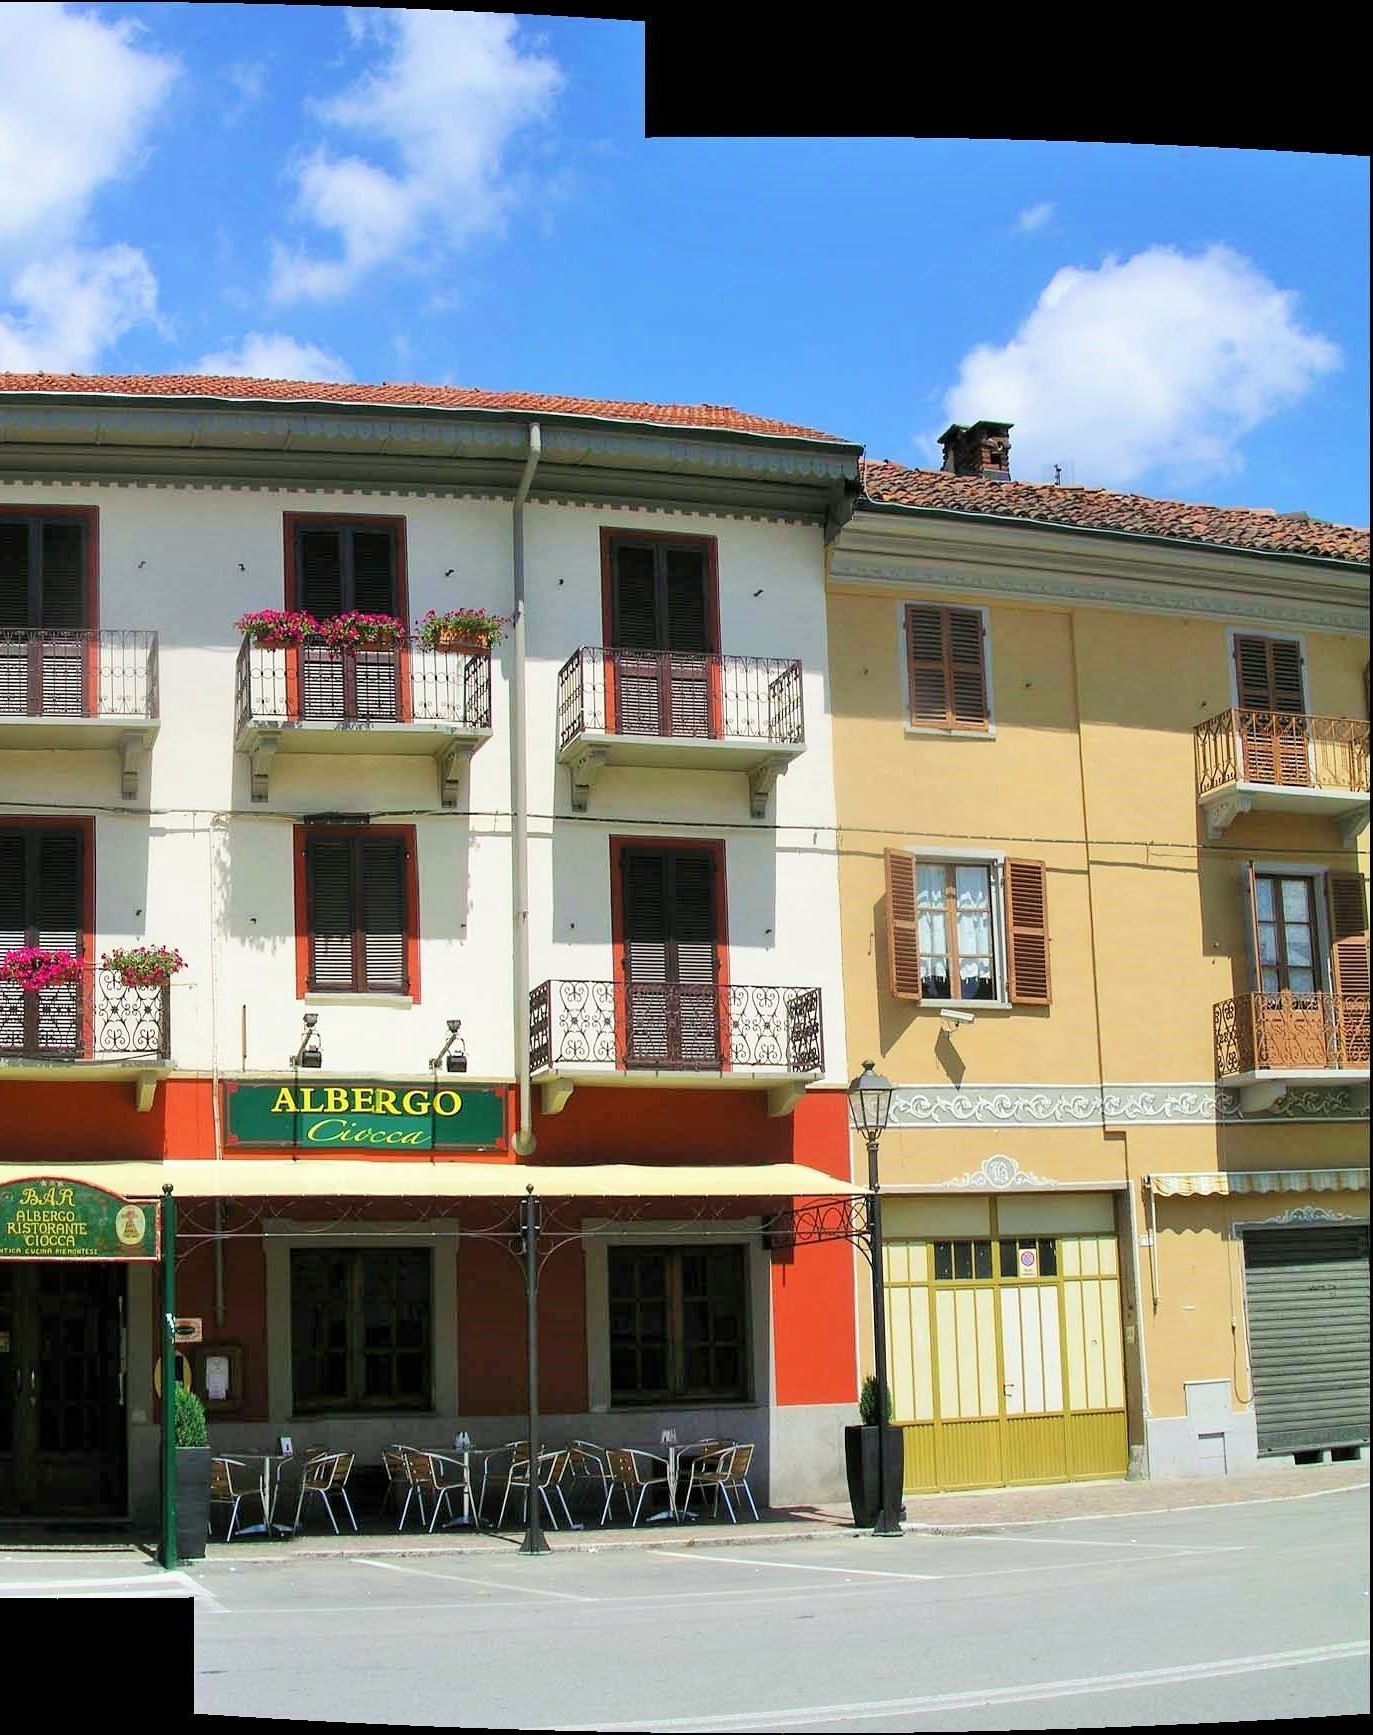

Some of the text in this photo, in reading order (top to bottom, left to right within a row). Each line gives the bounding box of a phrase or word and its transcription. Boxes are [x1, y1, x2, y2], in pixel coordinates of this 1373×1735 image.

[271, 1087, 462, 1116] ALBERGO
[306, 1118, 432, 1145] Ciocca
[19, 1187, 76, 1207] BAR
[16, 1210, 75, 1222] ALBERGO
[7, 1222, 88, 1235] RISTORANTE
[24, 1235, 76, 1248] CIOCCA
[24, 1247, 53, 1255] CUCINA
